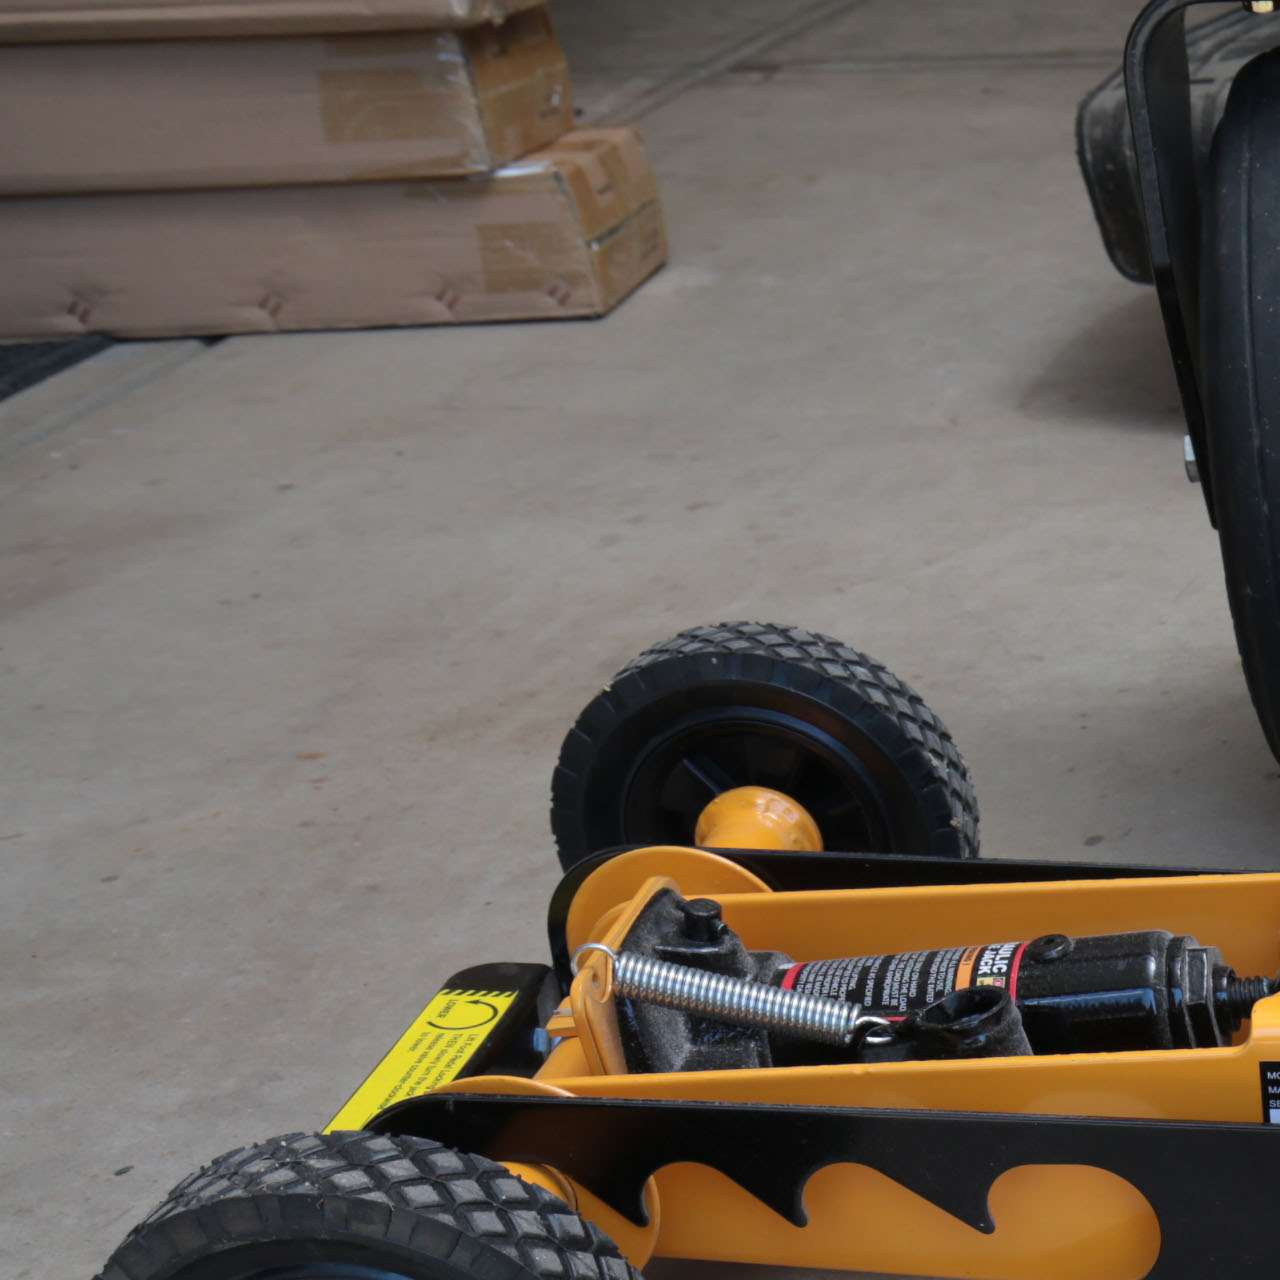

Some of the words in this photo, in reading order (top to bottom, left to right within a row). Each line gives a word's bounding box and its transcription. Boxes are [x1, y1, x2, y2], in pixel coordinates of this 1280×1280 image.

[977, 950, 992, 974] JACK
[863, 979, 875, 1006] SPECIFIED
[891, 982, 899, 997] MUST
[436, 999, 458, 1018] LOWER
[444, 1033, 462, 1048] THEN
